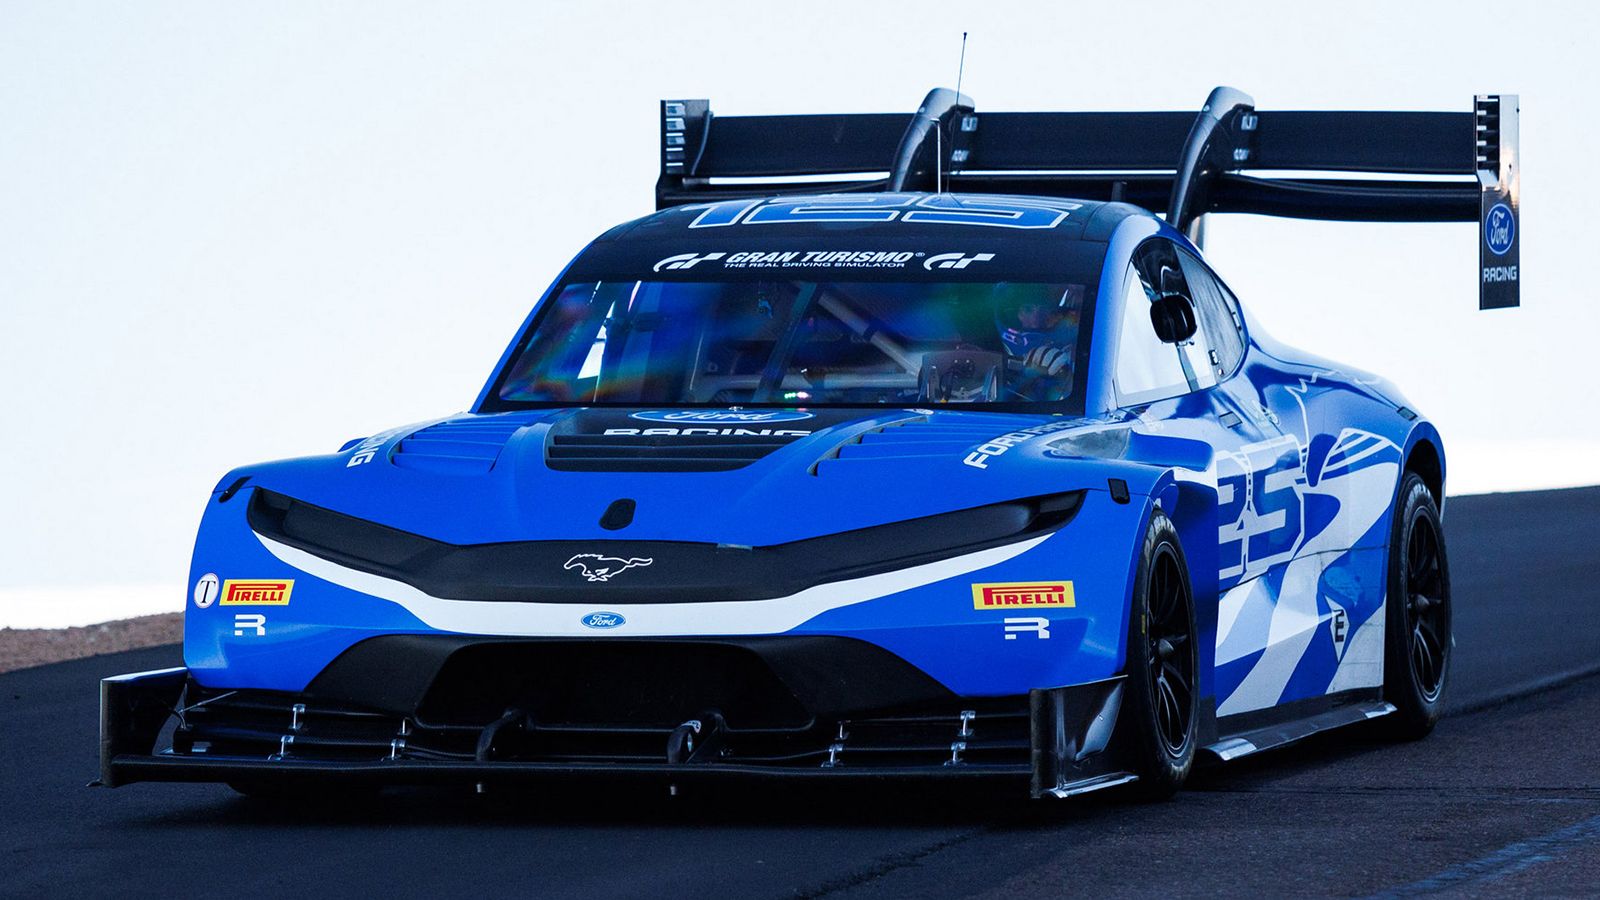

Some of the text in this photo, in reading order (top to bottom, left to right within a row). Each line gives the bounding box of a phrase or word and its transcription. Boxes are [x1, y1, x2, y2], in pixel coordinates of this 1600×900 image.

[1490, 209, 1510, 246] Ford
[726, 251, 800, 263] GRAN
[1483, 265, 1518, 283] RACING
[226, 583, 287, 602] PIRELLI
[982, 585, 1065, 606] PIRELLI
[589, 614, 618, 626] Ford
